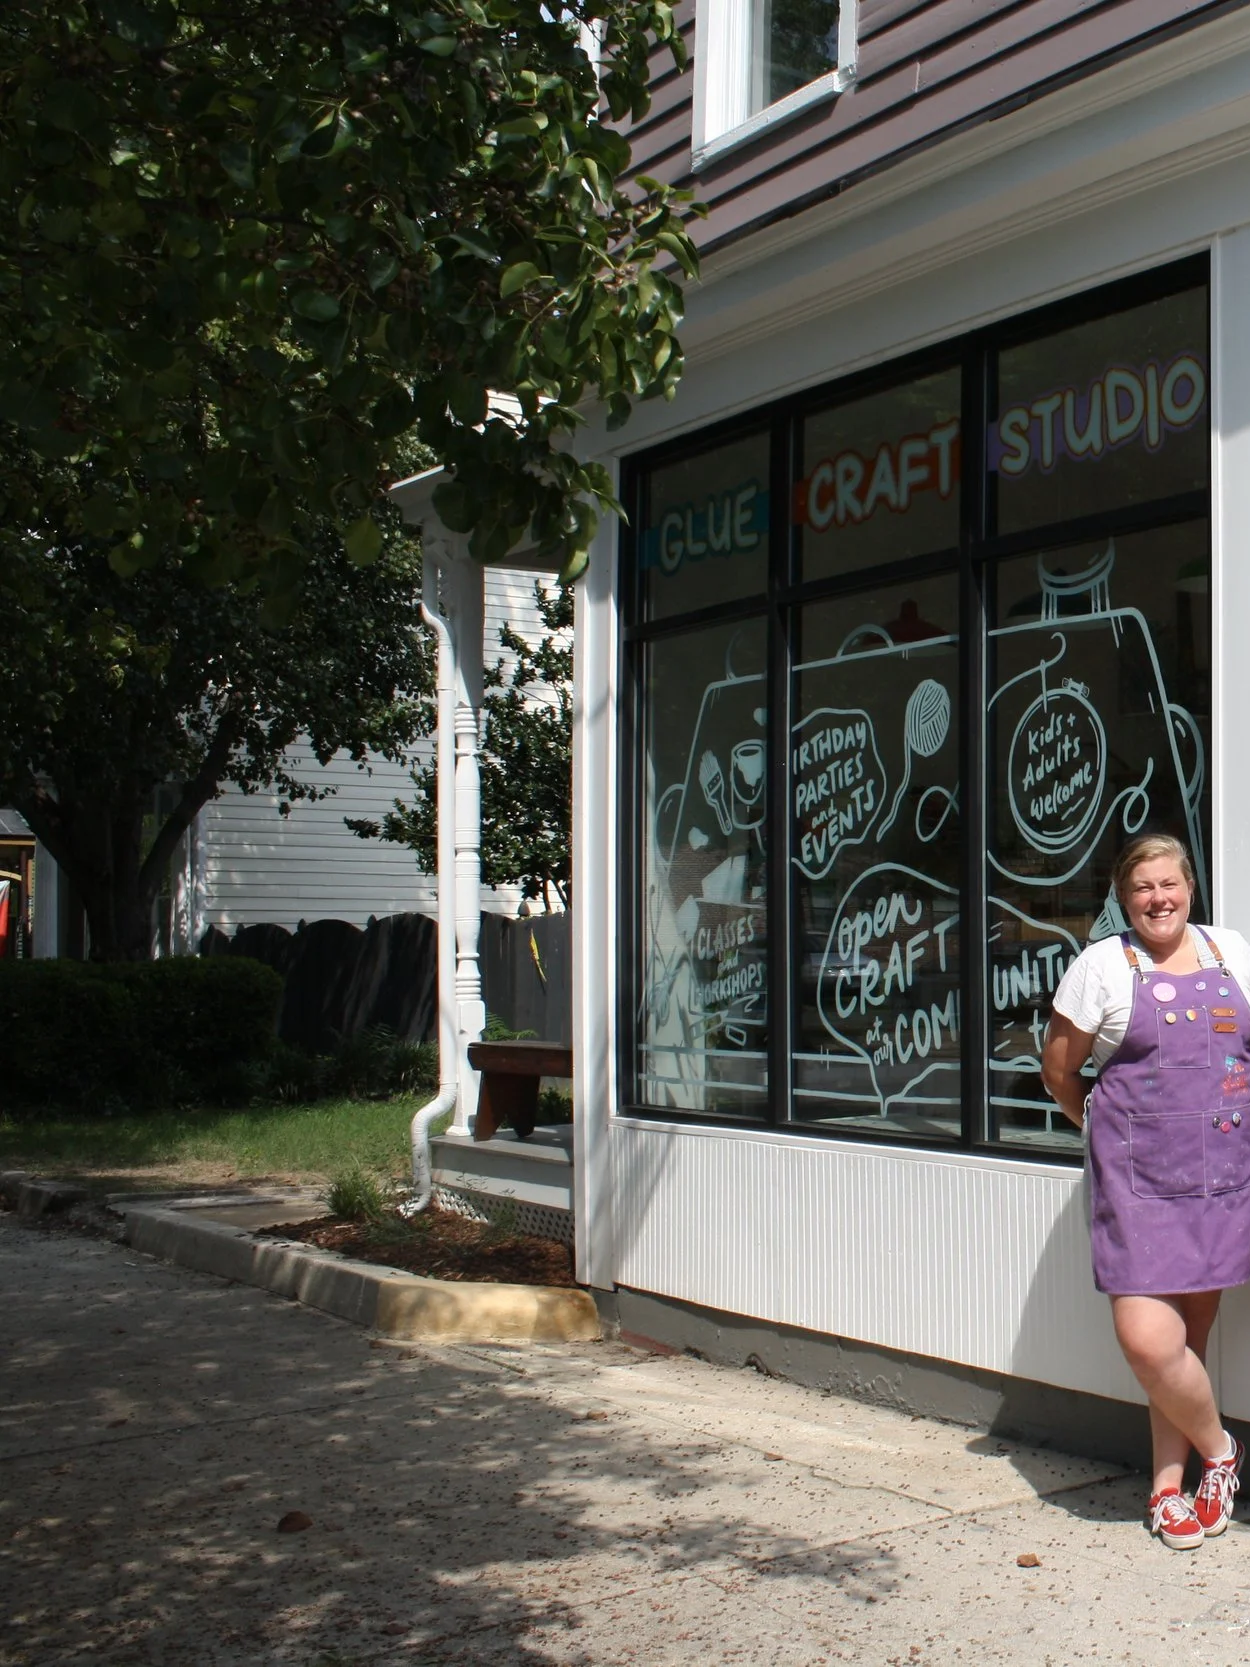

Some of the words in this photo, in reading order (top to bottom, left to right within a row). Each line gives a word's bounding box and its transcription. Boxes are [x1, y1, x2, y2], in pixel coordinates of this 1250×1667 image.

[659, 485, 760, 572] GLUE
[807, 425, 959, 529] CRAFT
[1000, 357, 1206, 475] STUDIO
[793, 722, 866, 775] IRTHDAY
[1028, 712, 1063, 755] Kids
[796, 752, 863, 818] PARTIES
[1022, 734, 1080, 792] Adults
[801, 779, 874, 864] EVENTS
[811, 799, 838, 829] and
[697, 914, 755, 960] CLASSES
[835, 913, 960, 1019] CRAFT
[866, 1016, 882, 1045] at
[873, 1033, 894, 1067] our
[895, 988, 960, 1064] COM
